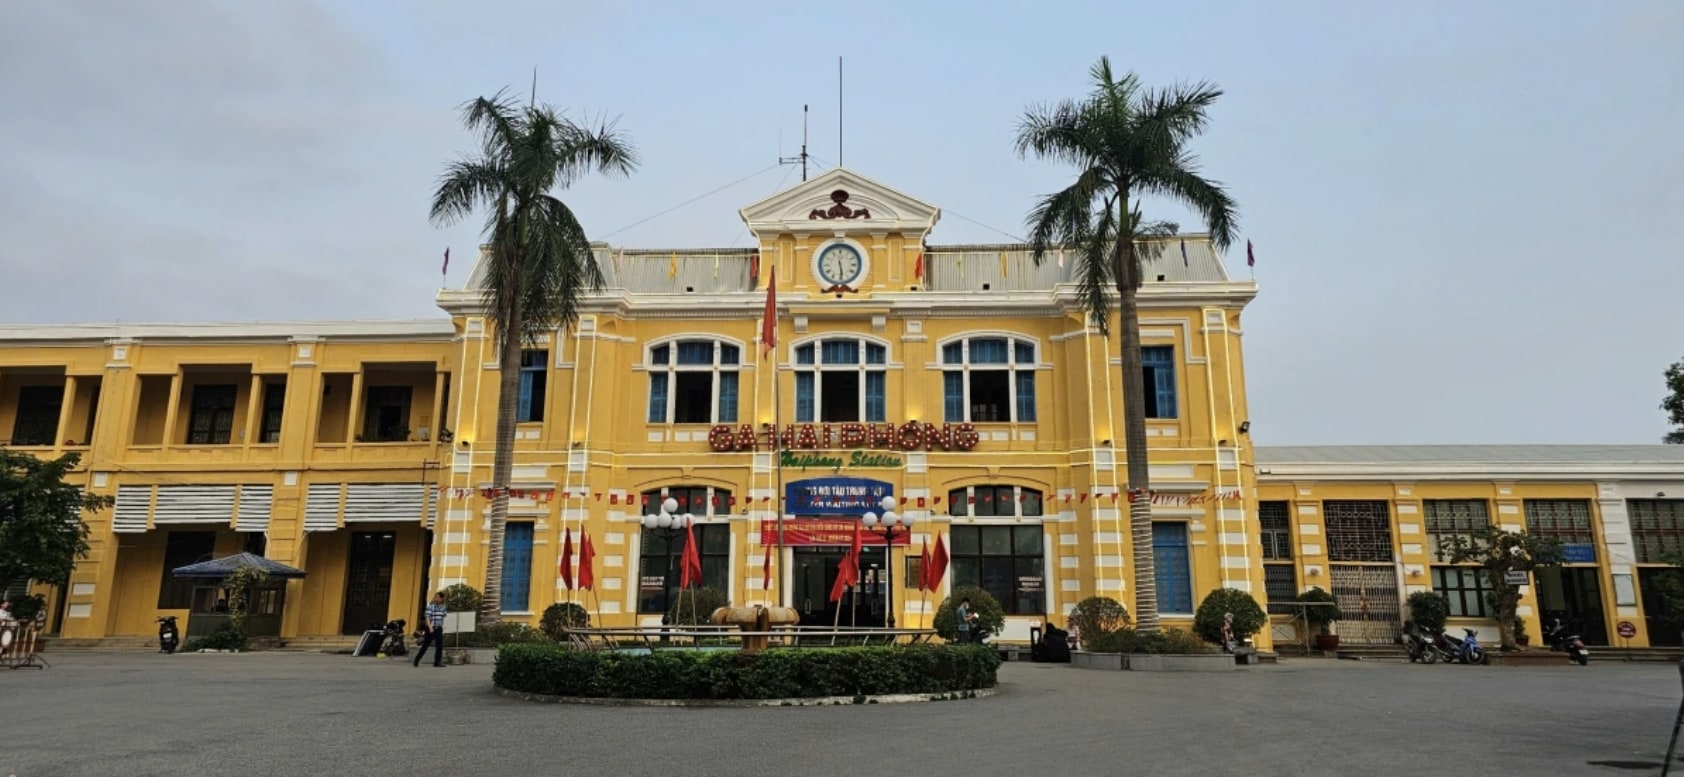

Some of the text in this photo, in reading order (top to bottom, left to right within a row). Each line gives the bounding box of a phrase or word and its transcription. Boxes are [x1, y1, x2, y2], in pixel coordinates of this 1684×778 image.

[709, 424, 758, 451] GA
[767, 423, 830, 450] HAI
[848, 451, 902, 468] Station
